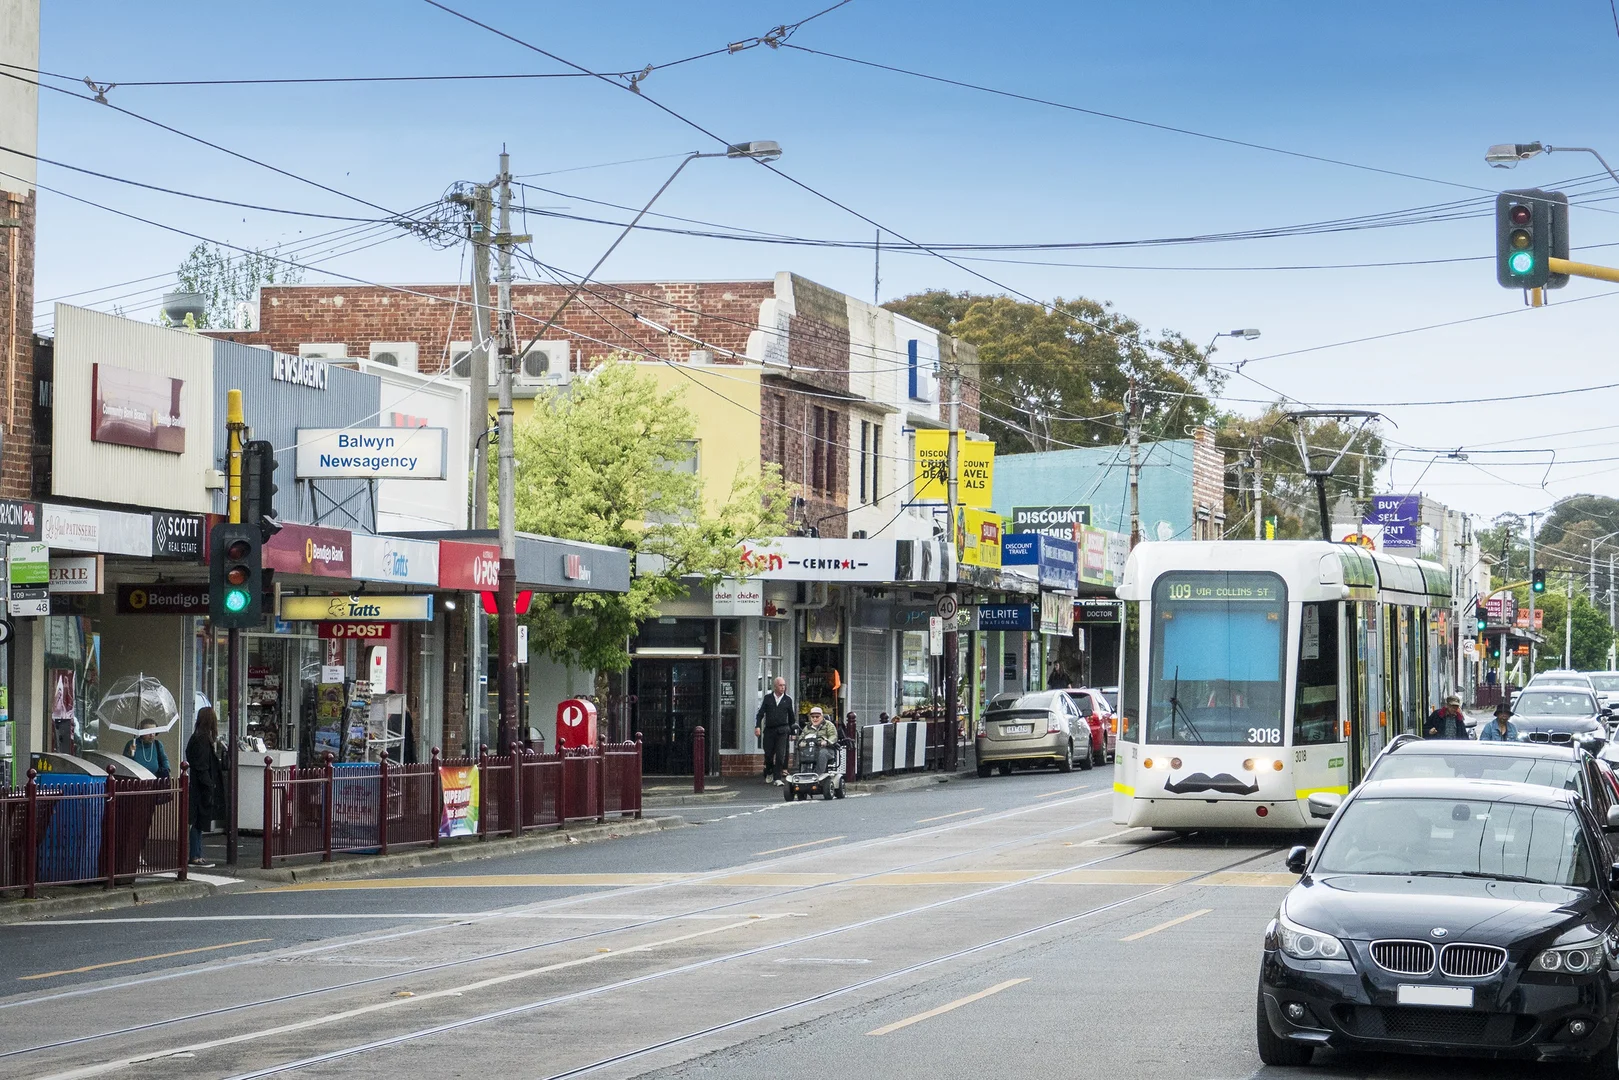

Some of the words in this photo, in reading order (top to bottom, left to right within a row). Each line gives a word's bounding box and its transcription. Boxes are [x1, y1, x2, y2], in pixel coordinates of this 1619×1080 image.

[273, 352, 329, 390] NEWSAGENCY
[338, 434, 394, 451] Balwyn
[320, 454, 417, 471] Newsagency
[964, 480, 985, 489] ALS
[1378, 501, 1400, 510] BUY
[1018, 510, 1085, 524] DISCOUNT
[1378, 513, 1400, 522] SELL
[66, 522, 97, 537] PATISSERIE
[168, 516, 198, 537] SCOTT
[1383, 526, 1405, 534] ENT
[168, 542, 180, 552] REAL
[181, 542, 197, 553] ESTATE
[312, 543, 332, 564] Bendigo
[332, 546, 344, 562] Bank
[392, 552, 408, 577] Tatts
[714, 592, 732, 600] chicken
[737, 592, 760, 600] chicken
[1169, 584, 1191, 599] 109
[1196, 588, 1212, 596] VIA
[1216, 588, 1252, 596] COLLINS
[1257, 588, 1269, 596] ST
[149, 594, 198, 608] Bendigo
[36, 604, 48, 612] 48
[348, 604, 381, 616] Tatts
[940, 602, 953, 614] 40
[979, 610, 1018, 619] VELRITE
[347, 624, 385, 636] POST
[1247, 728, 1281, 744] 3018
[1295, 750, 1307, 763] 3018
